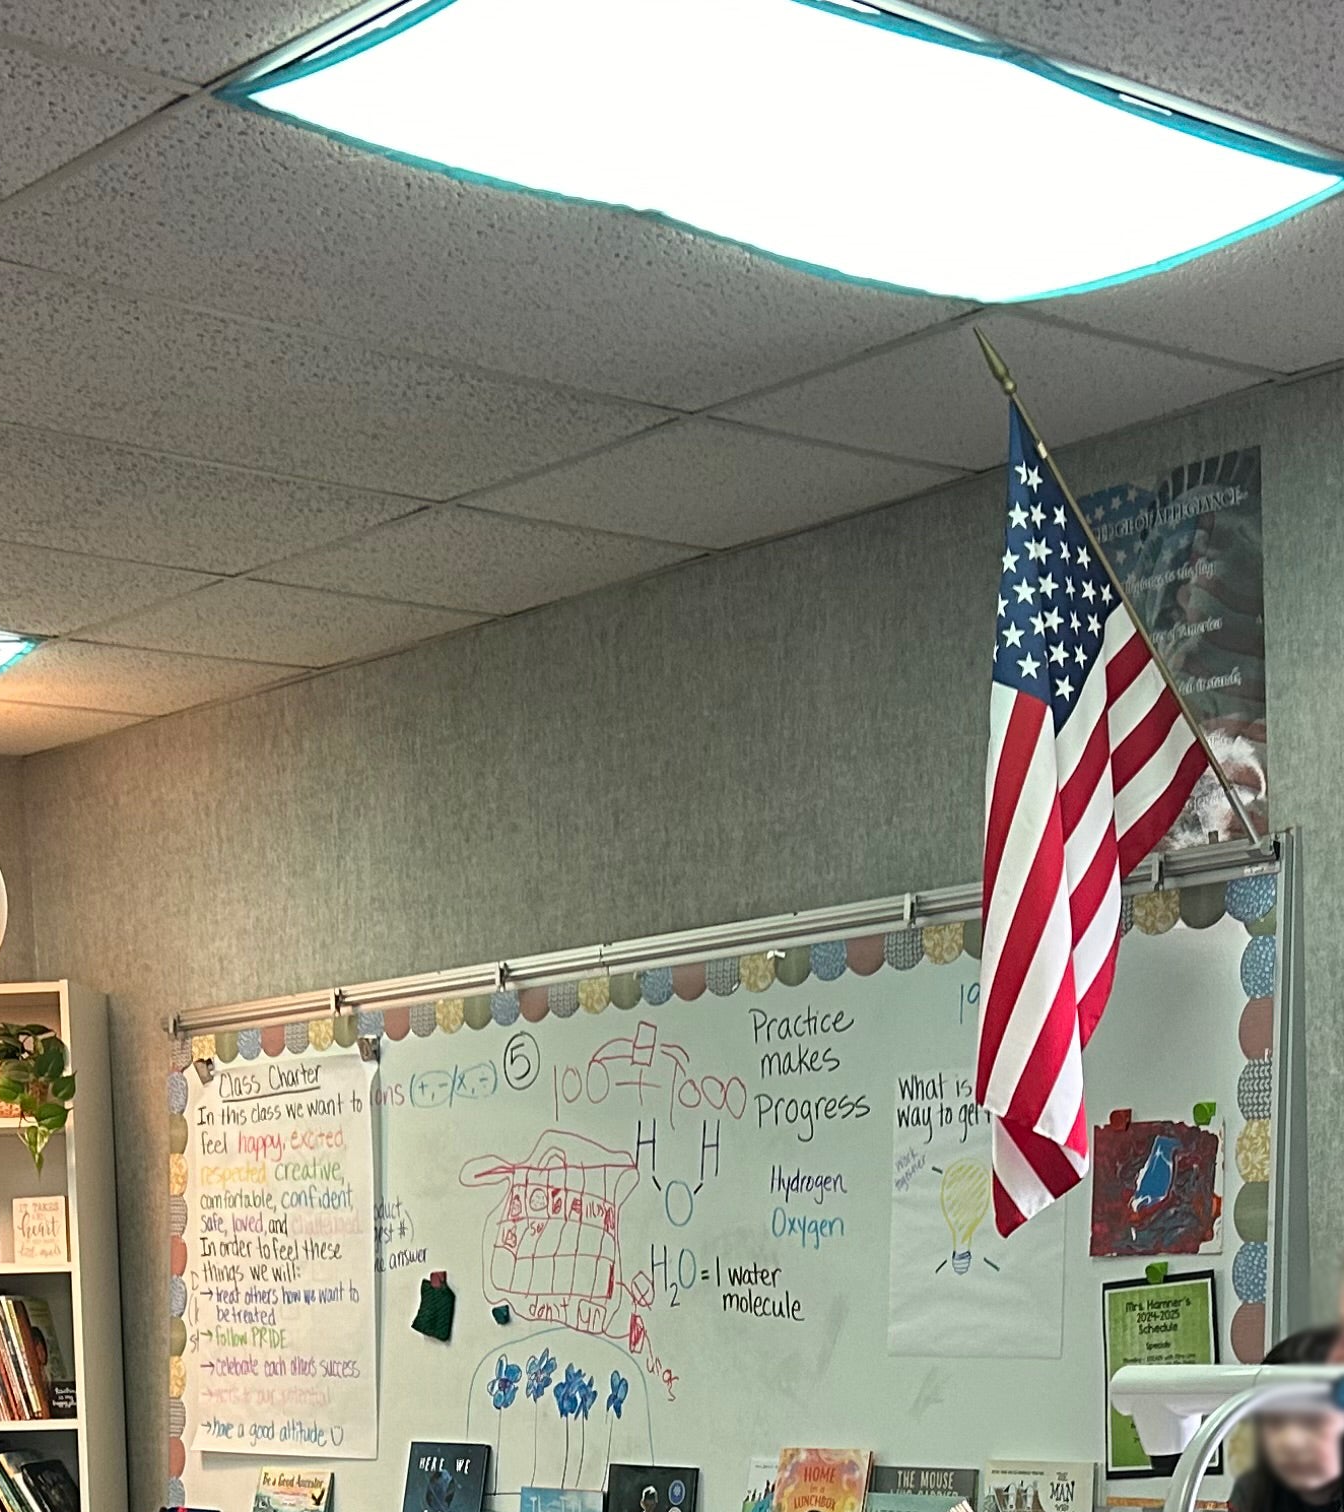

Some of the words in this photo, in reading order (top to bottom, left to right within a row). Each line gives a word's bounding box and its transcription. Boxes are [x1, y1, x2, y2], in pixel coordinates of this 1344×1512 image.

[749, 1006, 855, 1043] Practice
[761, 1044, 840, 1079] makes
[219, 1073, 260, 1098] Class
[269, 1064, 322, 1089] Charter
[898, 1072, 947, 1101] What
[956, 1073, 972, 1098] is
[197, 1106, 215, 1126] In
[221, 1104, 247, 1125] this
[251, 1102, 282, 1123] class
[287, 1102, 304, 1119] we
[307, 1093, 344, 1117] want
[351, 1090, 363, 1113] to
[755, 1093, 871, 1142] Progress
[897, 1103, 932, 1144] way
[939, 1103, 953, 1128] to
[201, 1131, 227, 1155] feel
[770, 1165, 847, 1205] Hydrogen
[268, 1213, 288, 1235] and
[772, 1207, 844, 1250] Oxygen
[200, 1236, 217, 1257] In
[220, 1235, 253, 1257] order
[258, 1236, 270, 1259] to
[273, 1234, 299, 1261] feel
[301, 1236, 343, 1261] these
[389, 1248, 427, 1270] answer
[204, 1261, 244, 1288] things
[250, 1264, 269, 1282] we
[728, 1265, 781, 1287] water
[216, 1287, 241, 1303] treat
[245, 1288, 279, 1305] others
[318, 1286, 345, 1302] want
[349, 1280, 360, 1302] to
[722, 1291, 805, 1321] molecule
[215, 1327, 248, 1346] follow
[252, 1327, 288, 1349] PRIDE
[1138, 1323, 1178, 1335] Schedule
[264, 1359, 287, 1378] each
[319, 1360, 361, 1379] success
[237, 1426, 244, 1437] a
[250, 1425, 276, 1447] good
[280, 1419, 328, 1447] attitude
[419, 1456, 445, 1472] HERE
[456, 1458, 471, 1475] WE
[804, 1466, 837, 1484] HOME
[897, 1470, 916, 1488] THE
[920, 1470, 955, 1490] MOUSE
[1050, 1480, 1075, 1502] MAN
[793, 1495, 836, 1511] LUNCHBOX
